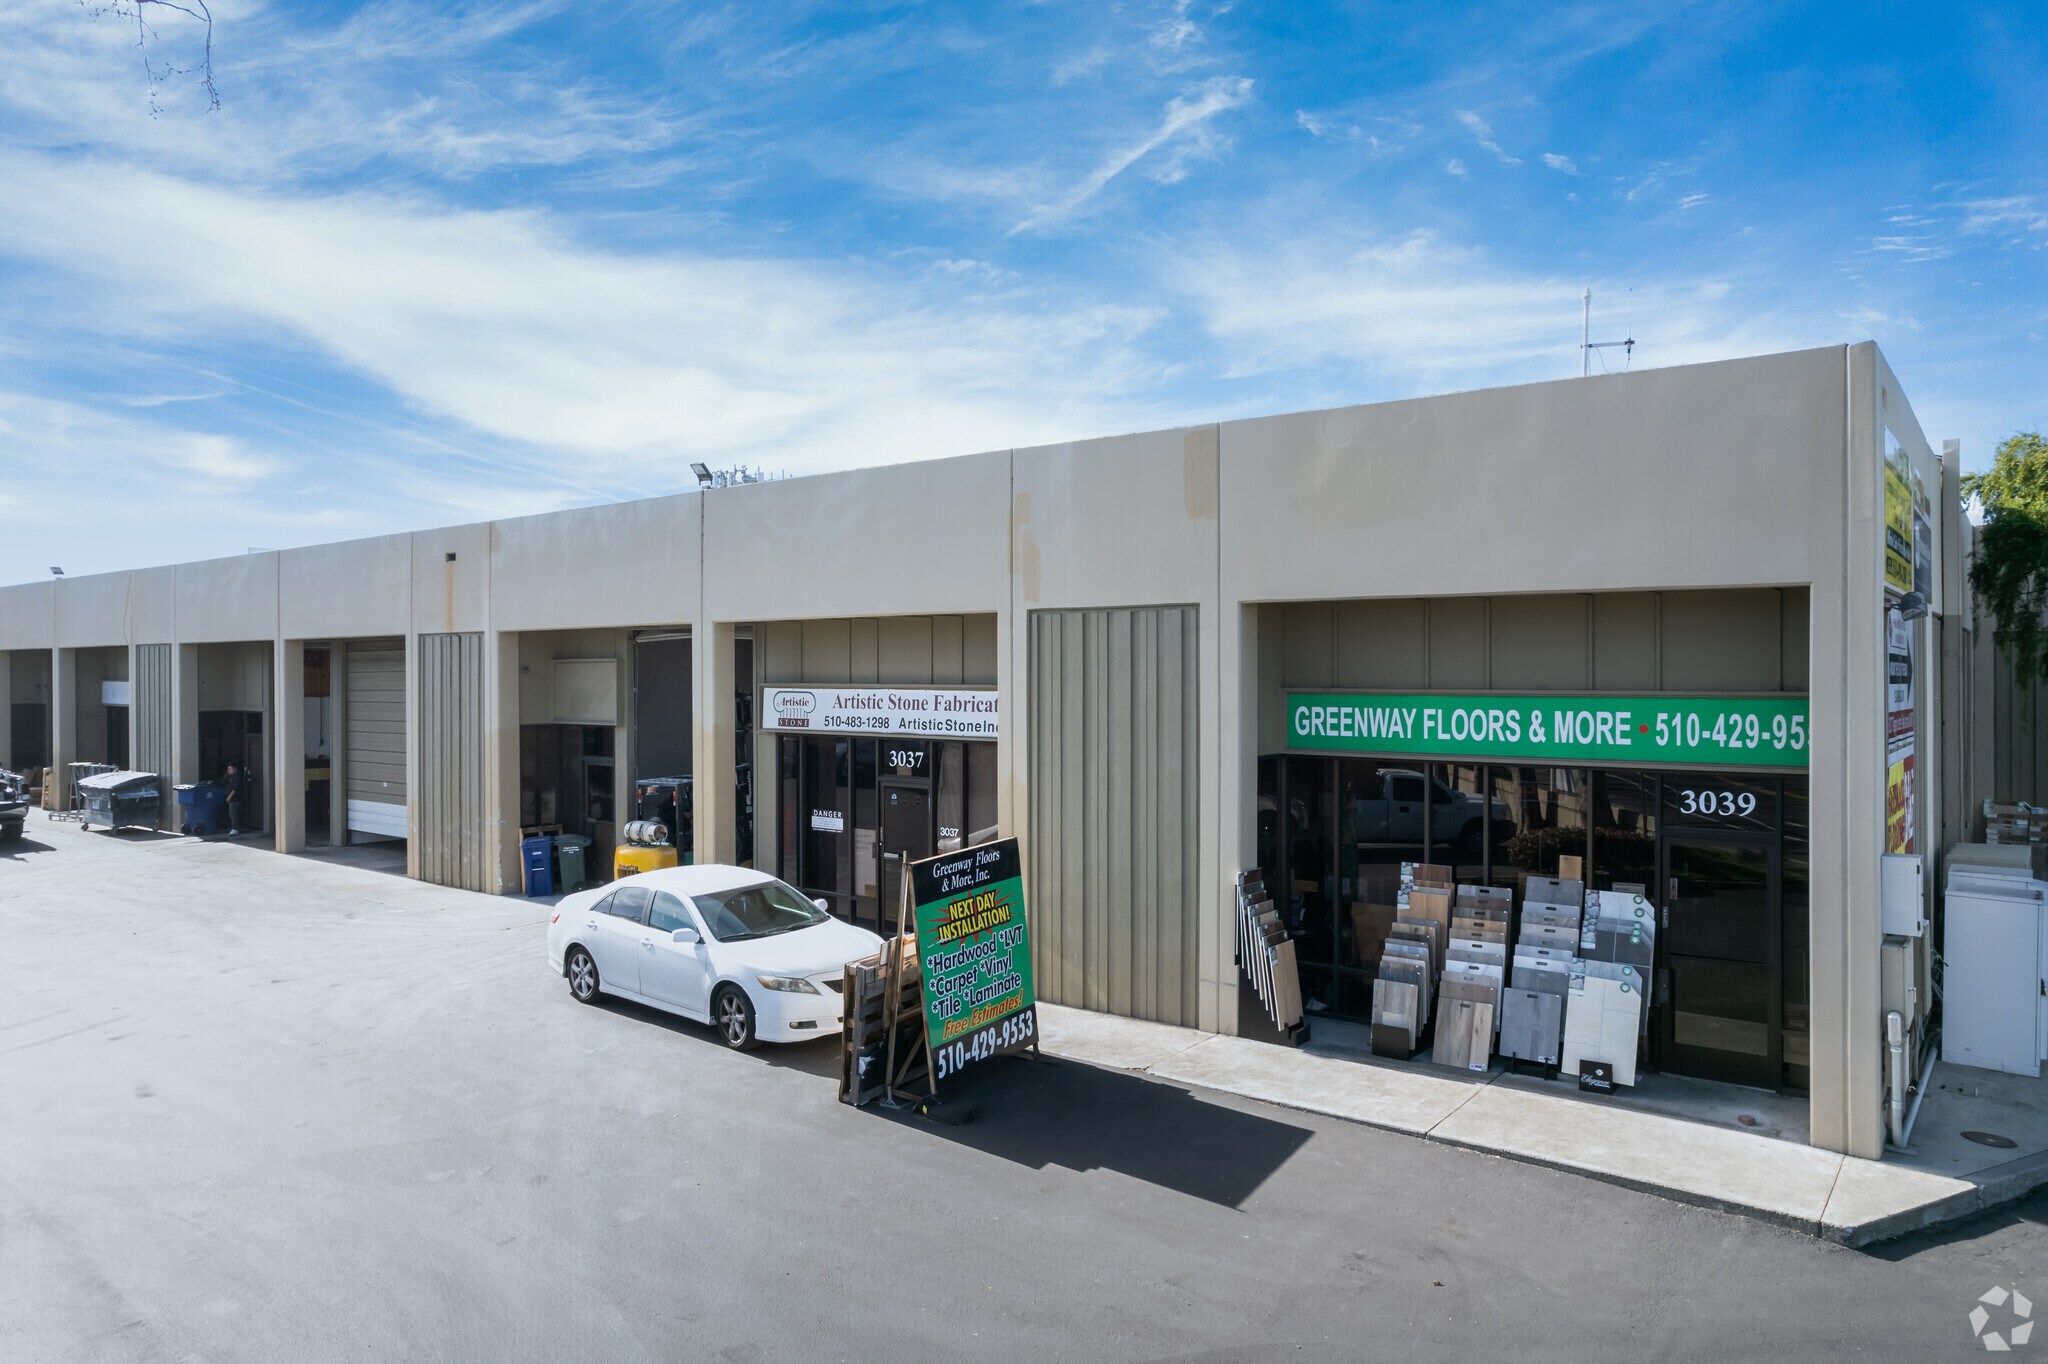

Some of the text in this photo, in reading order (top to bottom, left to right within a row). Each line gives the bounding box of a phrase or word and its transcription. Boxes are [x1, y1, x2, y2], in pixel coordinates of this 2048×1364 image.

[776, 696, 810, 708] Artistic
[832, 693, 884, 710] Artistic
[888, 693, 929, 712] Stone
[779, 719, 809, 727] STONE
[824, 716, 890, 729] 510-483-1298
[1295, 706, 1810, 750] GREENWAY FLOORS & MORE 510-429-95
[889, 750, 924, 768] 3037
[813, 809, 842, 818] DANGER
[1680, 790, 1756, 817] 3039
[940, 827, 959, 837] 3037
[932, 850, 1001, 878] Greenway Floors
[941, 868, 990, 892] & More, Inc.
[949, 891, 996, 920] NEXT DAY
[938, 905, 1010, 940] INSTALLATION!
[943, 988, 1023, 1040] Free Estimates!
[938, 1010, 1033, 1079] 510-429-9553
